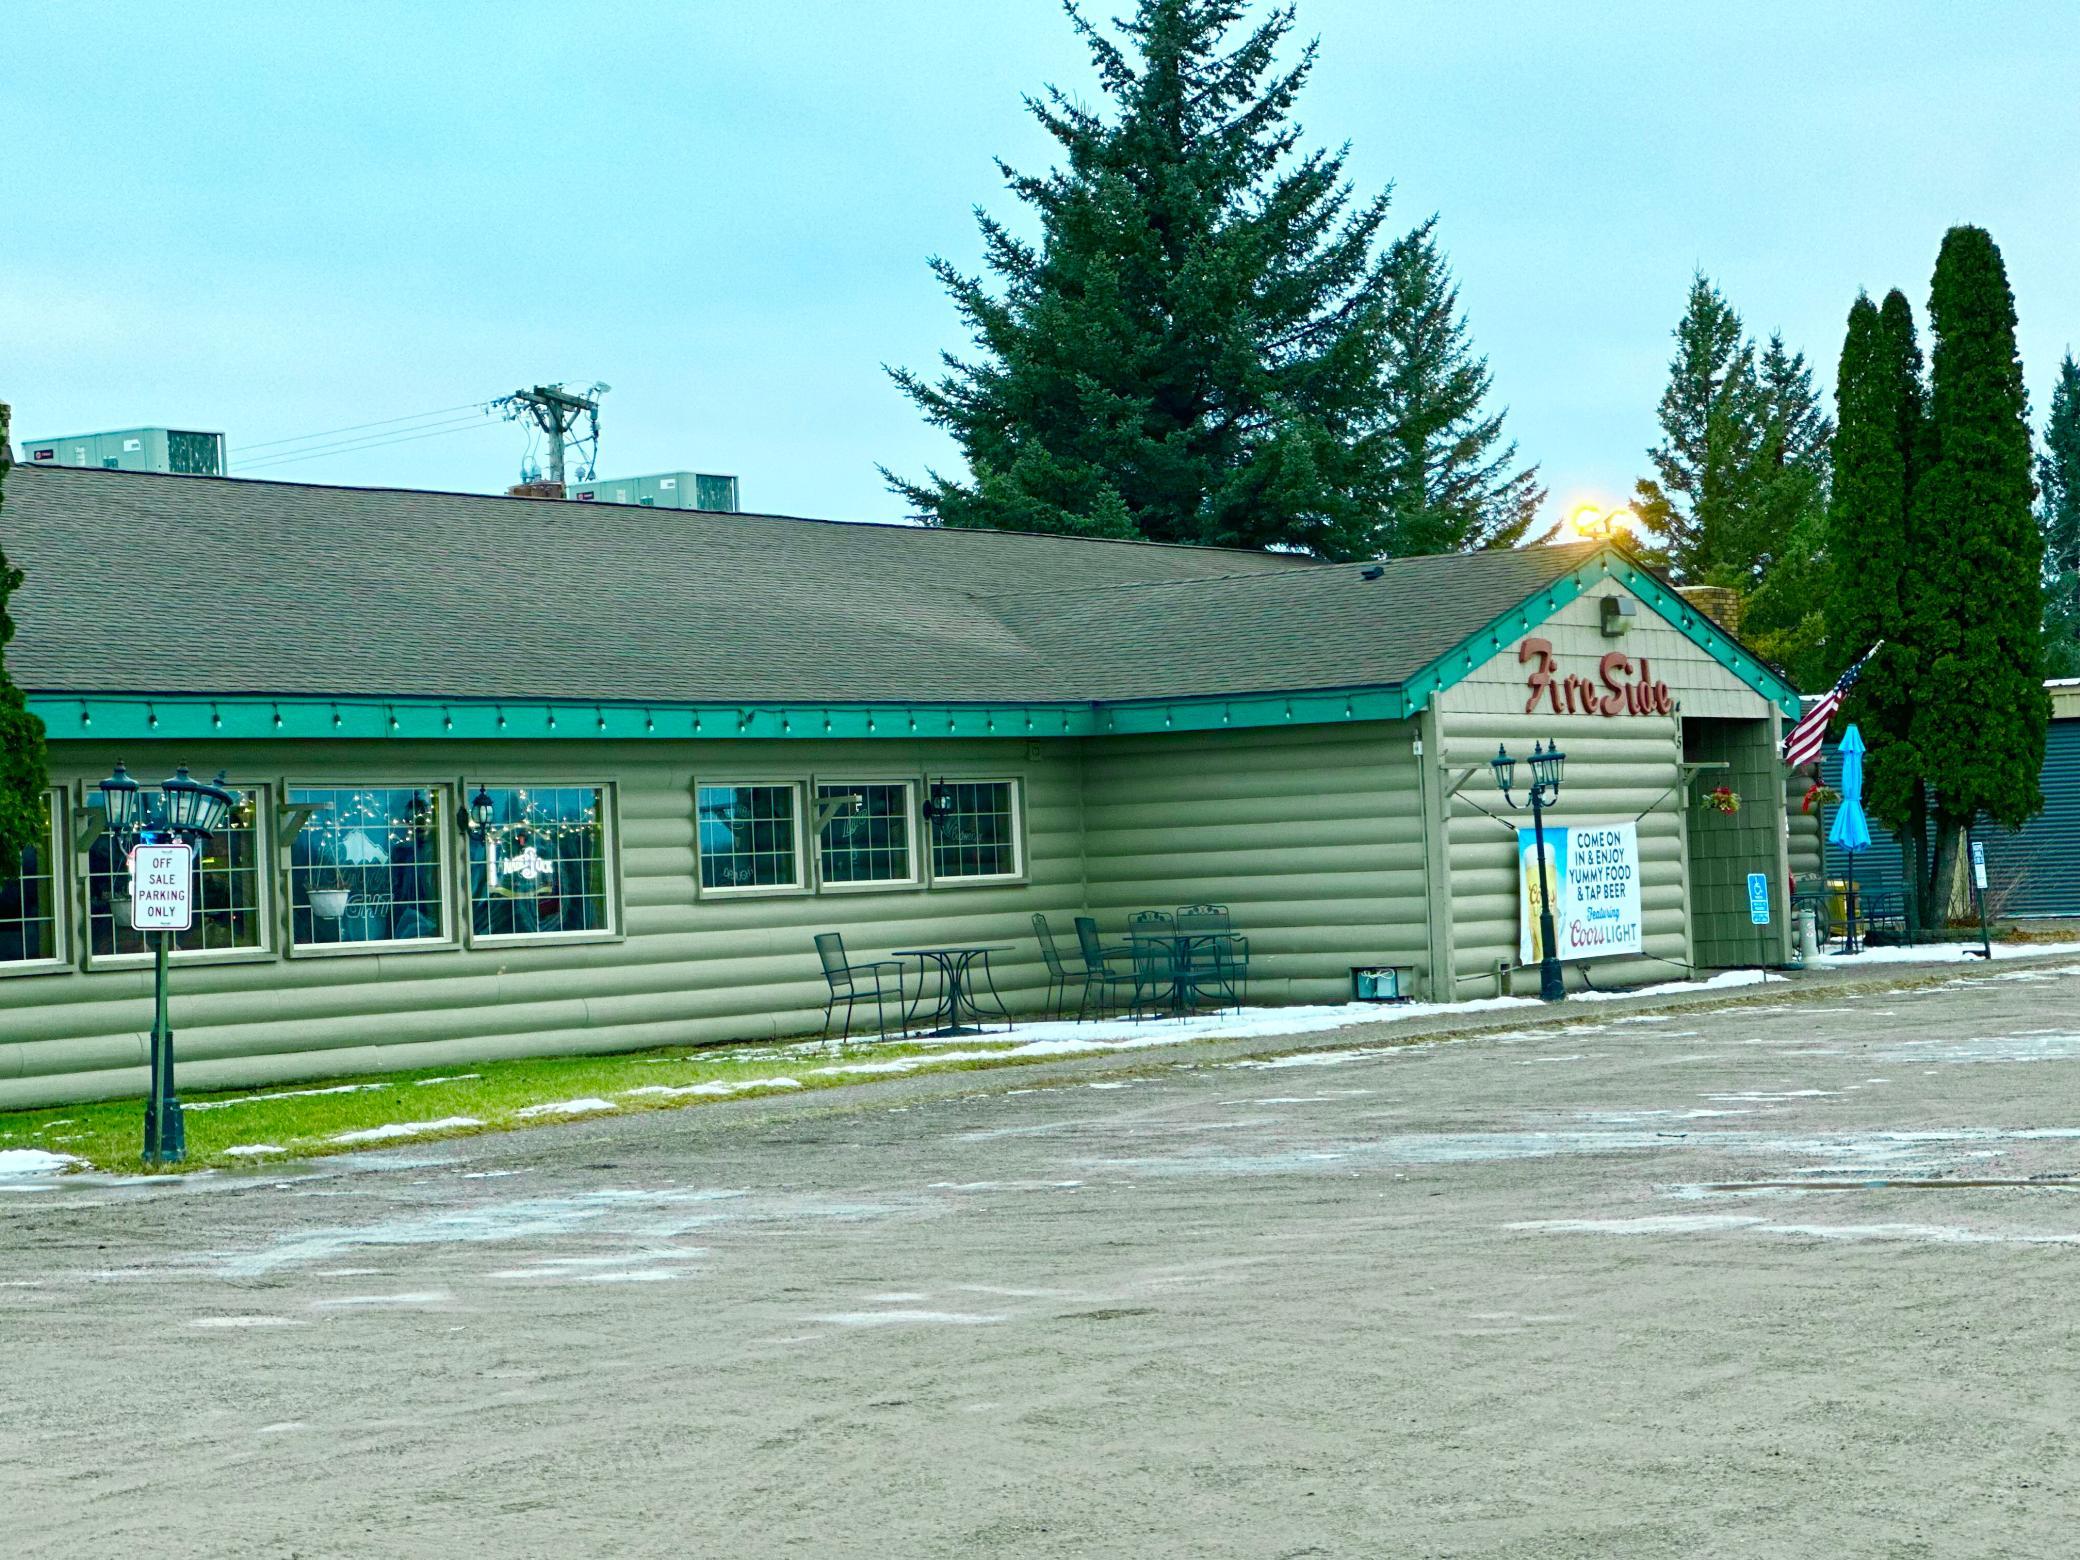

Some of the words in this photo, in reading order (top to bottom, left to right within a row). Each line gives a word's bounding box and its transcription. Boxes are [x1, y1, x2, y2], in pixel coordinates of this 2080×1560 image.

[1577, 831, 1605, 849] COME
[1606, 831, 1621, 847] ON
[152, 857, 173, 869] OFF
[1575, 850, 1586, 866] IN
[1587, 850, 1595, 865] &
[1596, 848, 1625, 865] ENJOY
[148, 874, 175, 885] SALE
[1569, 867, 1603, 884] YUMMY
[1605, 865, 1632, 881] FOOD
[138, 890, 186, 901] PARKING
[1577, 886, 1585, 902] &
[1584, 884, 1602, 901] TAP
[1603, 882, 1626, 899] BEER
[147, 906, 176, 918] ONLY
[1587, 906, 1620, 922] Featuring
[1569, 919, 1605, 948] Coors
[1605, 923, 1637, 944] LIGHT
